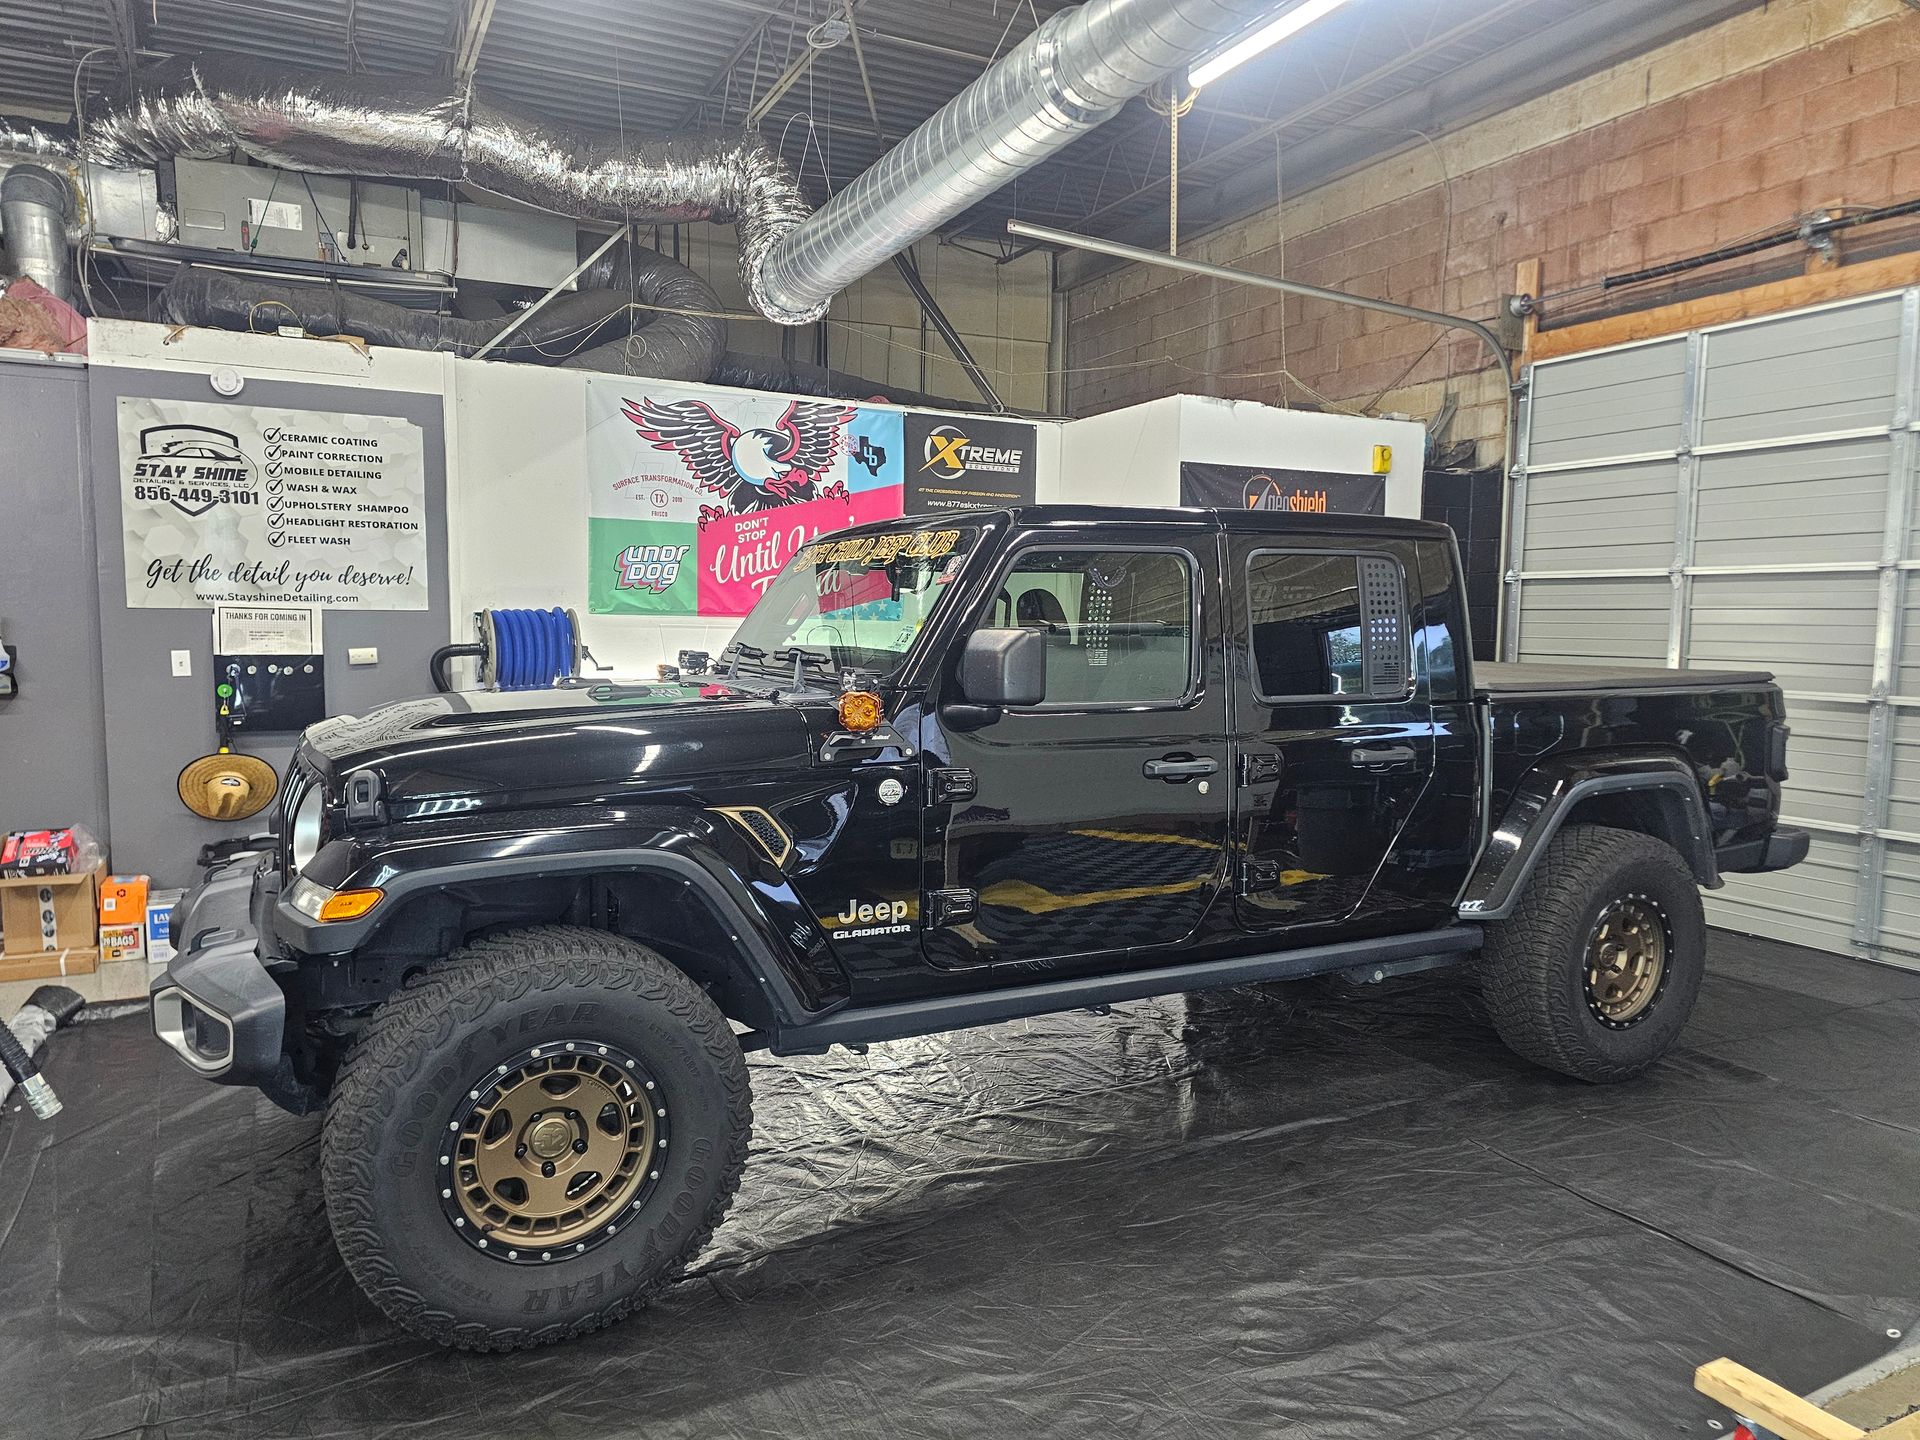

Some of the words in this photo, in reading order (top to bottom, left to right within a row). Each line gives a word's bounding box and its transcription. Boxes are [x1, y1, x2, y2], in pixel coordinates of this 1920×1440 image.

[281, 433, 328, 444] CERAMIC
[331, 437, 378, 447] COATING
[282, 450, 314, 459] PAINT
[317, 452, 383, 463] CORRECTION
[919, 435, 1023, 473] XTREME
[134, 463, 187, 478] STAY
[193, 466, 248, 481] SHINE
[284, 466, 324, 476] MOBILE
[327, 469, 381, 479] DETAILING
[969, 464, 1016, 473] SOLUTIONS
[286, 483, 318, 493] WASH
[321, 485, 329, 493] &
[332, 486, 357, 494] WAX
[612, 475, 640, 491] SURFACE
[640, 474, 695, 490] TRANSFORMATION
[135, 486, 259, 505] 856-449-3101
[654, 493, 665, 504] TX
[285, 501, 352, 511] UPHOLSTERY
[357, 504, 409, 514] SHAMPOO
[286, 518, 345, 527] HEADLIGHT
[348, 520, 418, 530] RESTORATION
[735, 517, 769, 533] DON'T
[288, 535, 316, 544] FLEET
[320, 536, 350, 545] WASH
[738, 529, 766, 544] STOP
[710, 531, 782, 584] Until
[146, 558, 185, 588] Get
[187, 553, 222, 583] the
[228, 560, 290, 585] detail
[295, 570, 333, 592] you
[338, 565, 413, 587] deserve!
[195, 592, 359, 604] www.StayshineDetailing.com
[225, 612, 253, 620] THANKS
[254, 612, 269, 620] FOR
[270, 613, 297, 621] COMING
[299, 613, 306, 621] IN
[838, 899, 909, 924] Jeep
[833, 924, 911, 940] GLADIATOR
[111, 934, 135, 947] BAGS
